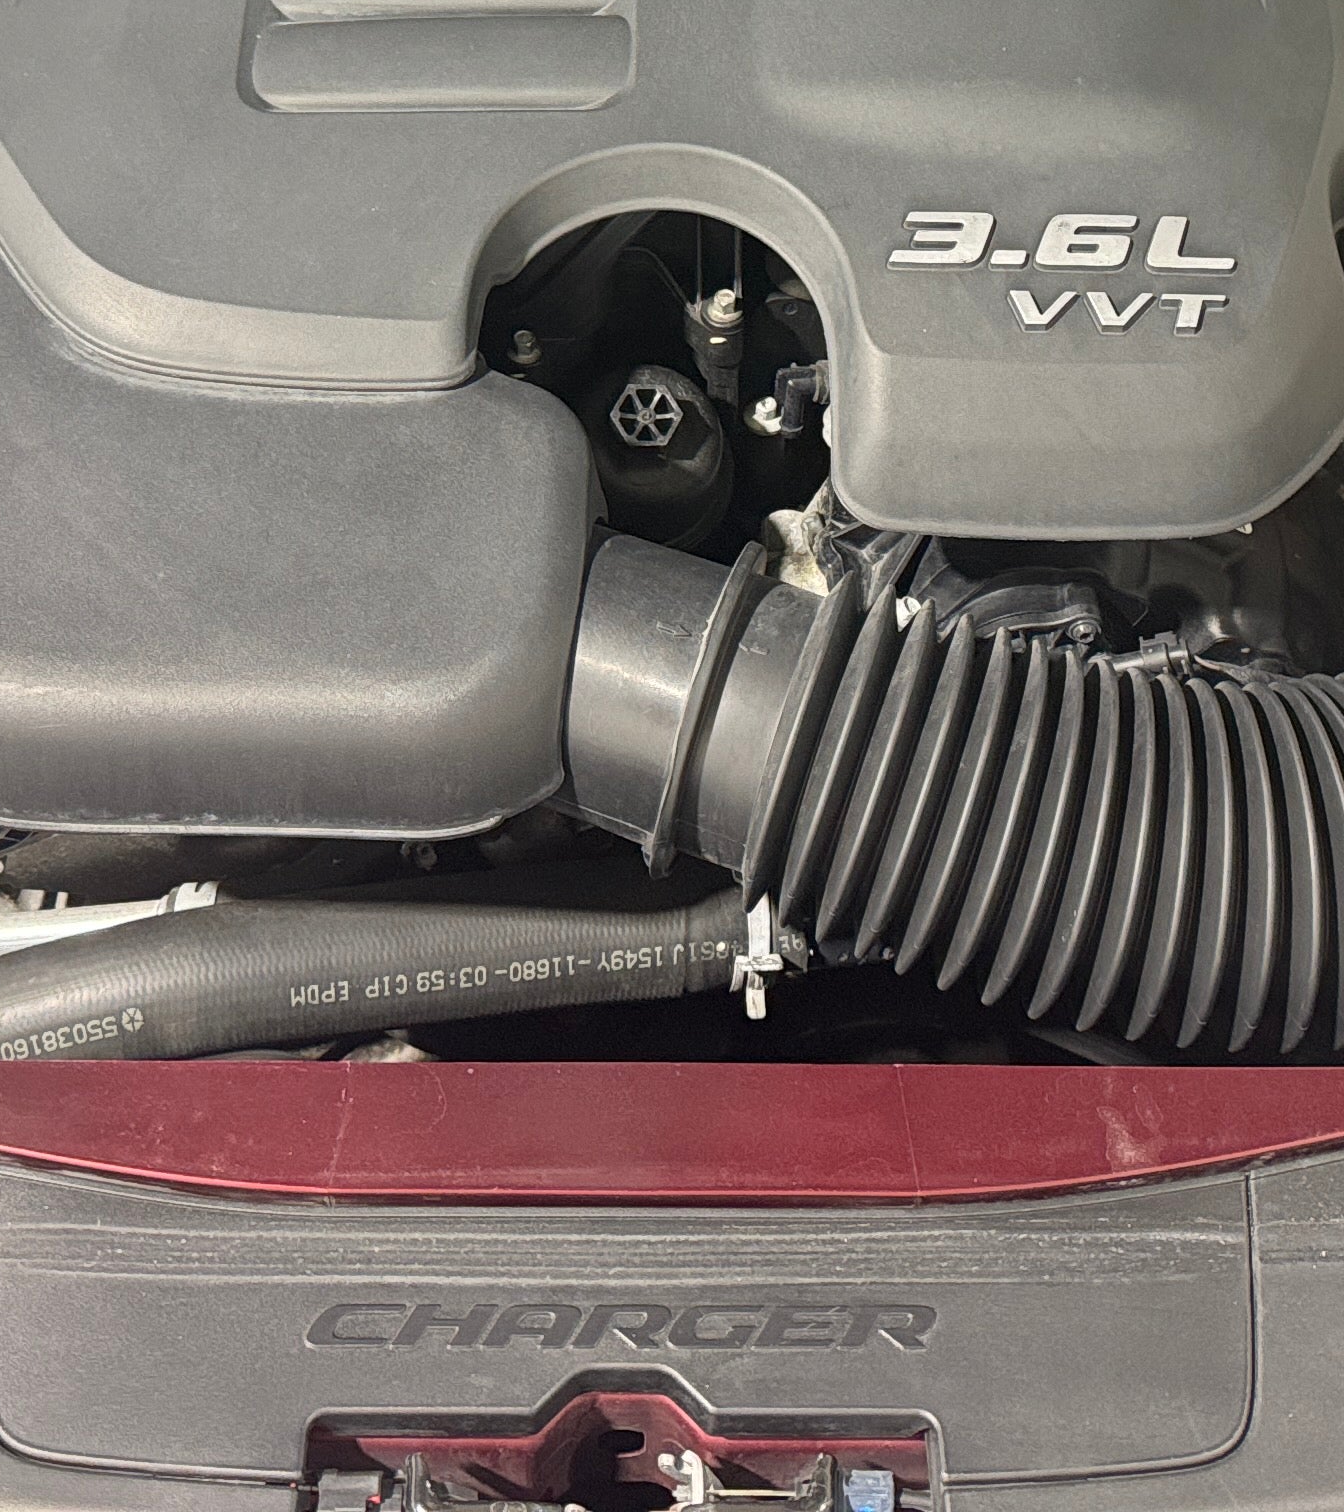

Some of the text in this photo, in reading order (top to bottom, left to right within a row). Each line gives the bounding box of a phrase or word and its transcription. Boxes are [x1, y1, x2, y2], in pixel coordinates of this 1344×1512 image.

[886, 209, 1236, 274] 3.6L
[1007, 288, 1228, 336] VVT
[598, 944, 664, 971] 1549Y
[288, 979, 350, 1008] EPDM
[415, 965, 488, 994] 03:59
[305, 1301, 939, 1352] CHARGER
